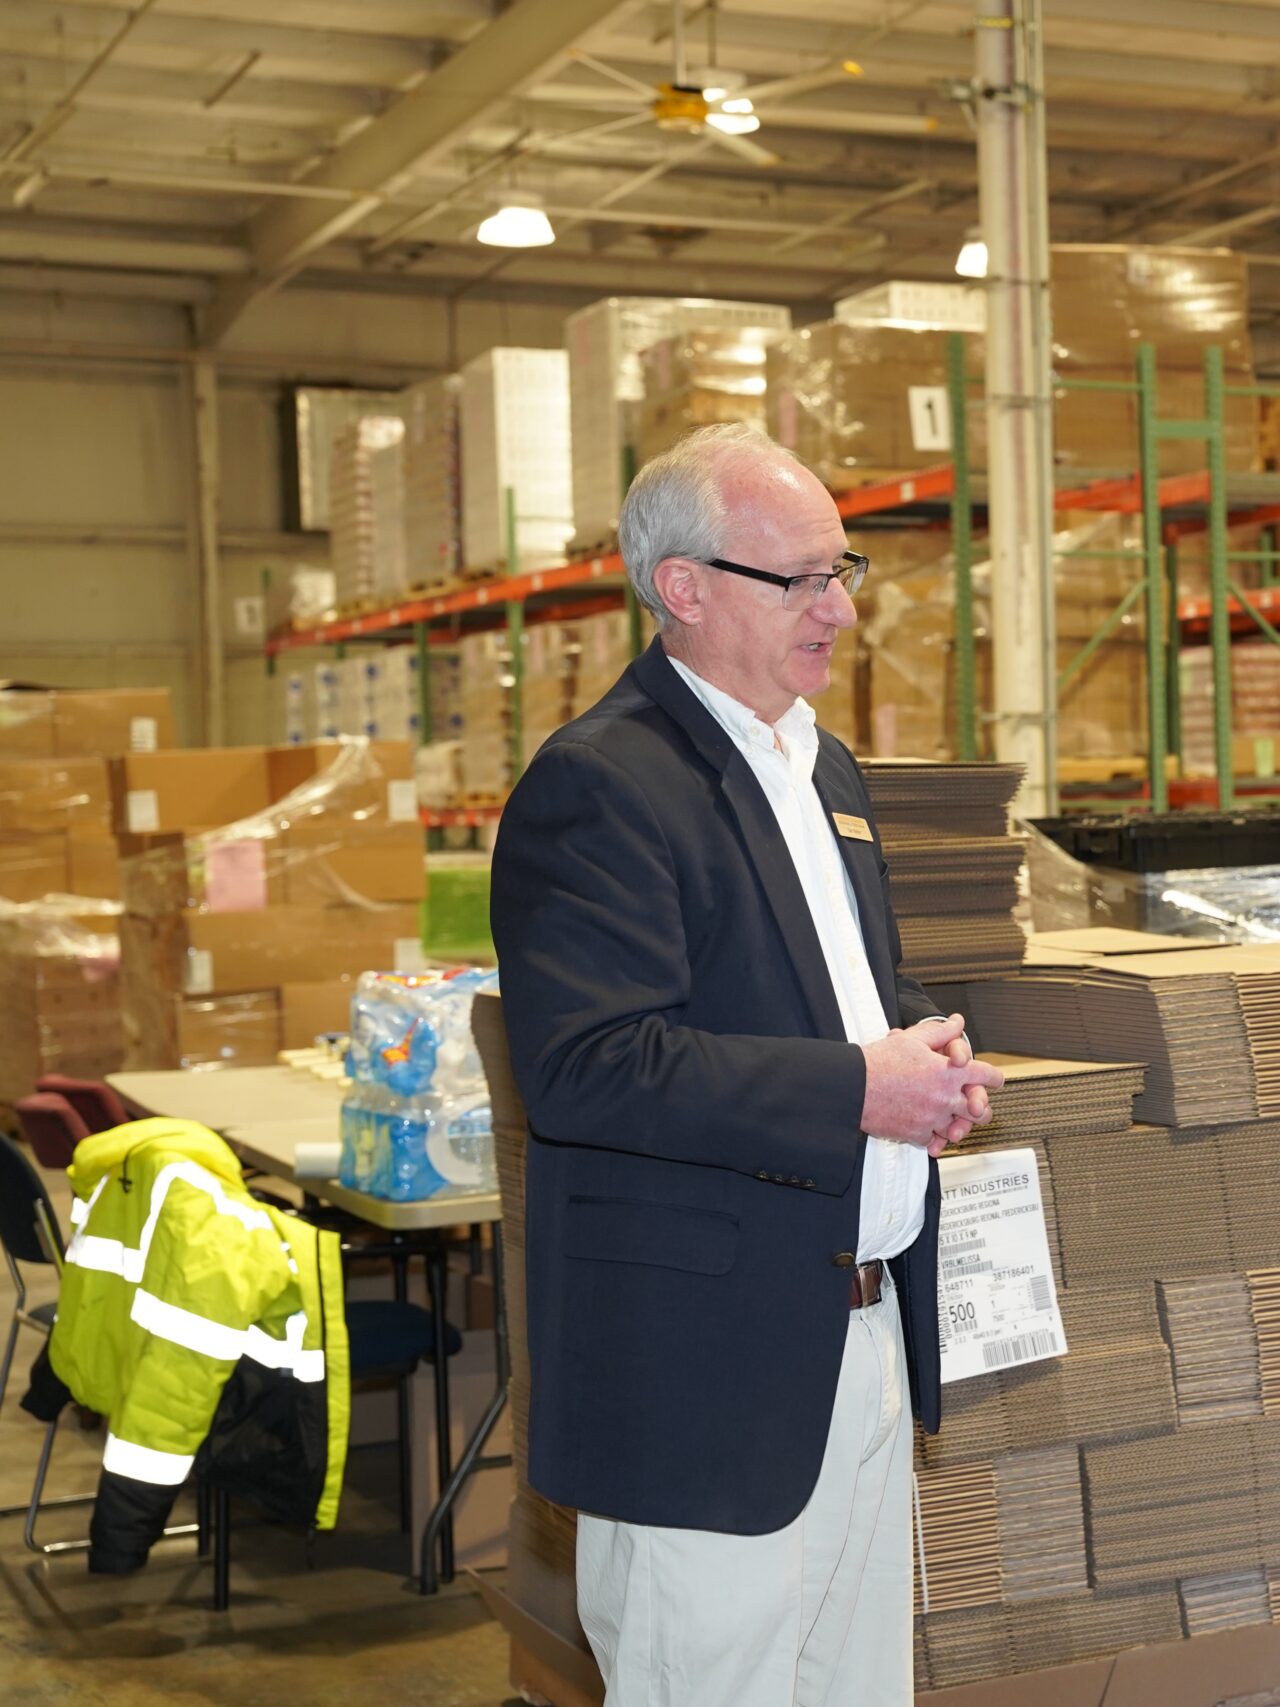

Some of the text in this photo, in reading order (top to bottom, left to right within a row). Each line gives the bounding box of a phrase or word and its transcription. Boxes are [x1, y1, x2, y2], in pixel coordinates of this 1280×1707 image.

[924, 397, 937, 438] 1
[961, 1174, 1029, 1197] INDUSTRIES
[945, 1279, 974, 1293] 648711
[949, 1301, 975, 1324] 500
